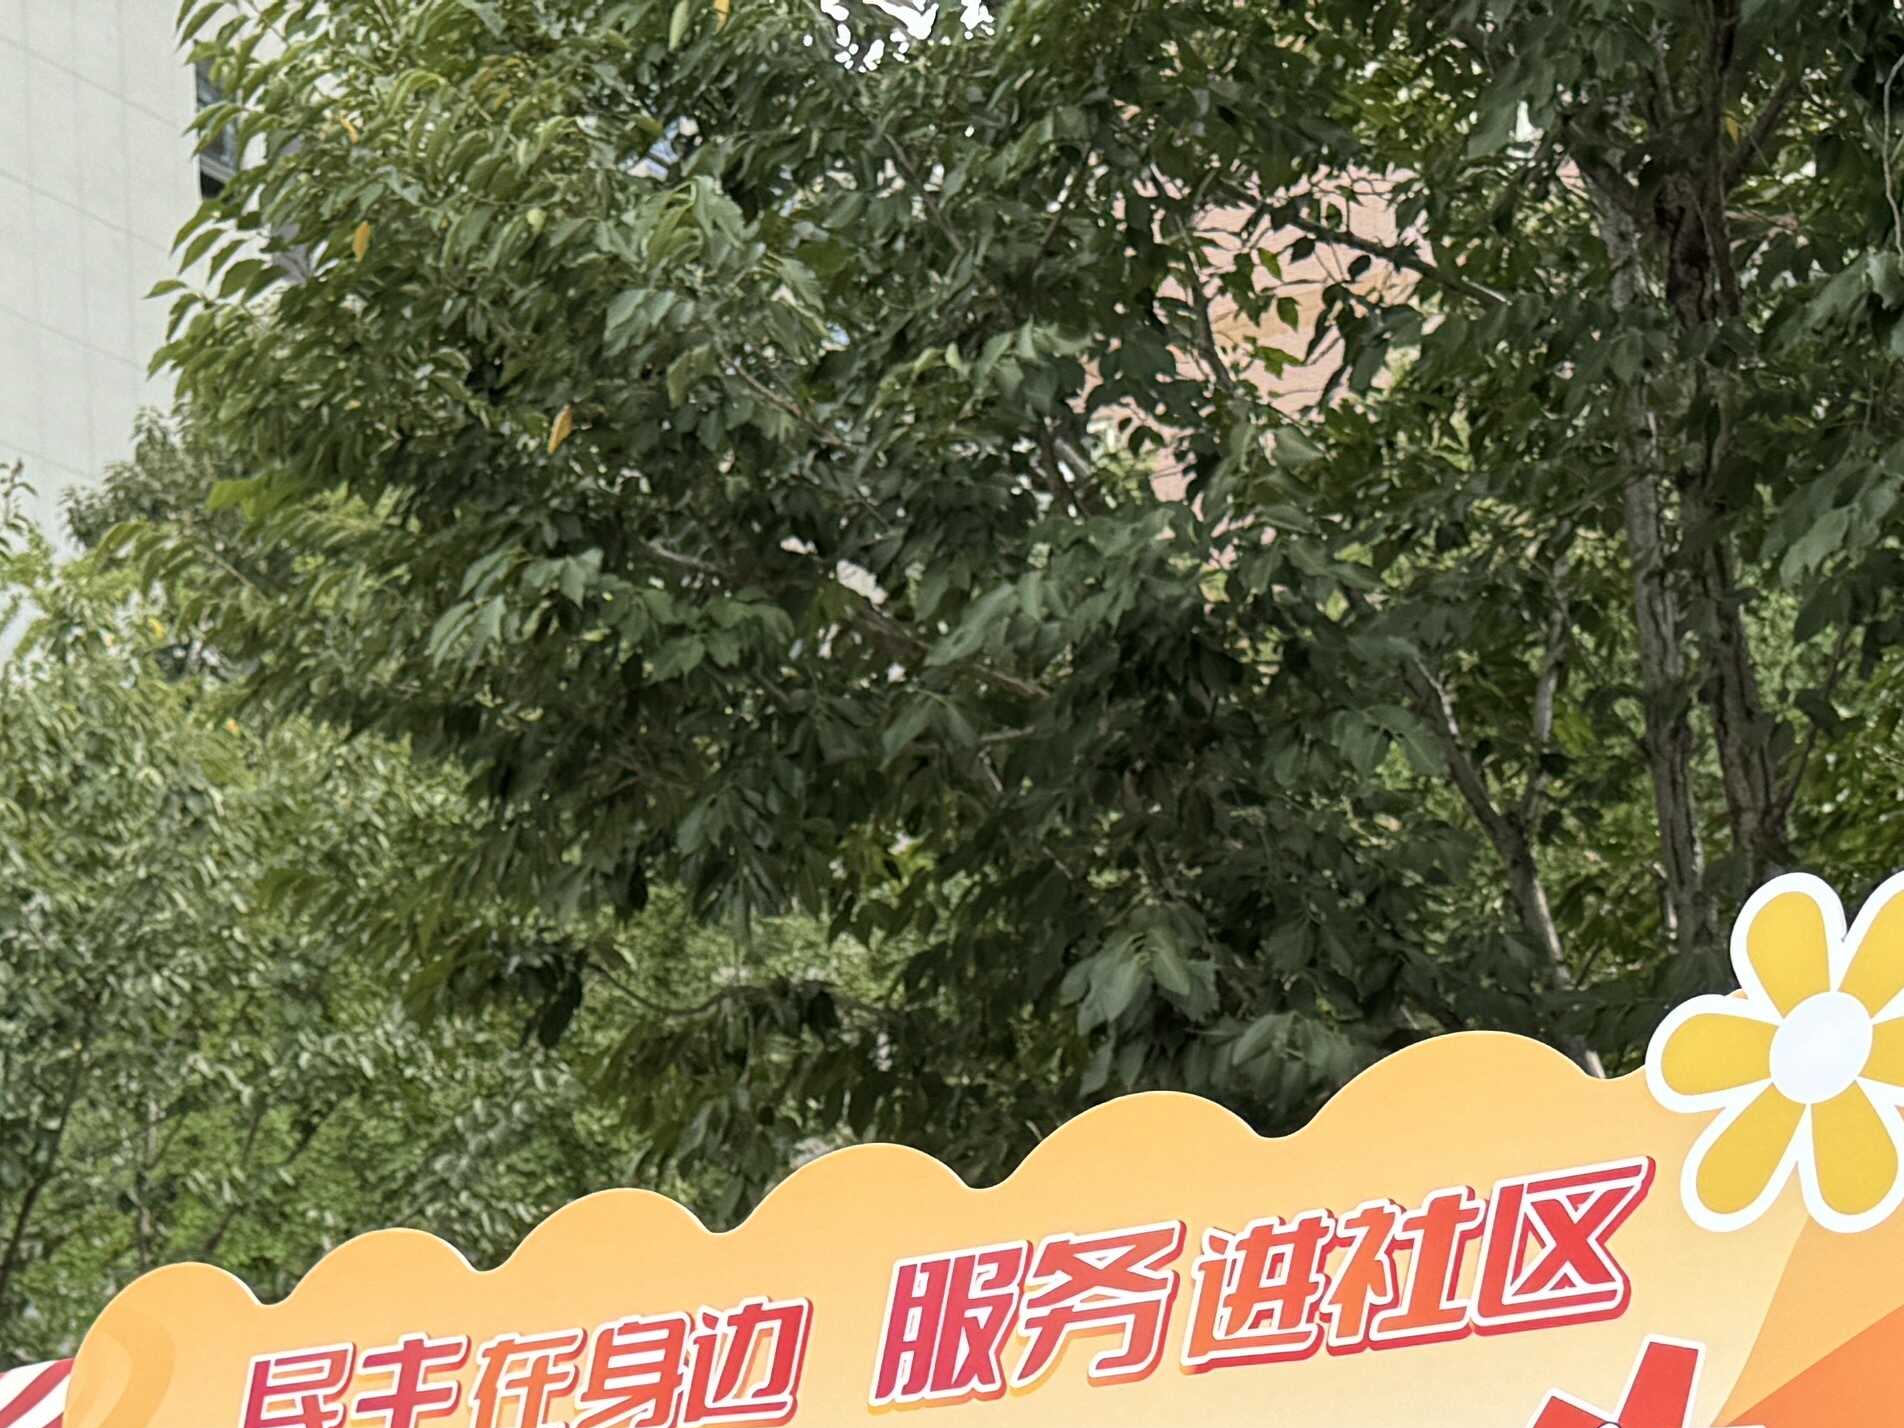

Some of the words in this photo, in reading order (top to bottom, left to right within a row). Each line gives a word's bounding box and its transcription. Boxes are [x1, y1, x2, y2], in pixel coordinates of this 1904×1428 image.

[871, 1155, 1656, 1412] 服务进社区
